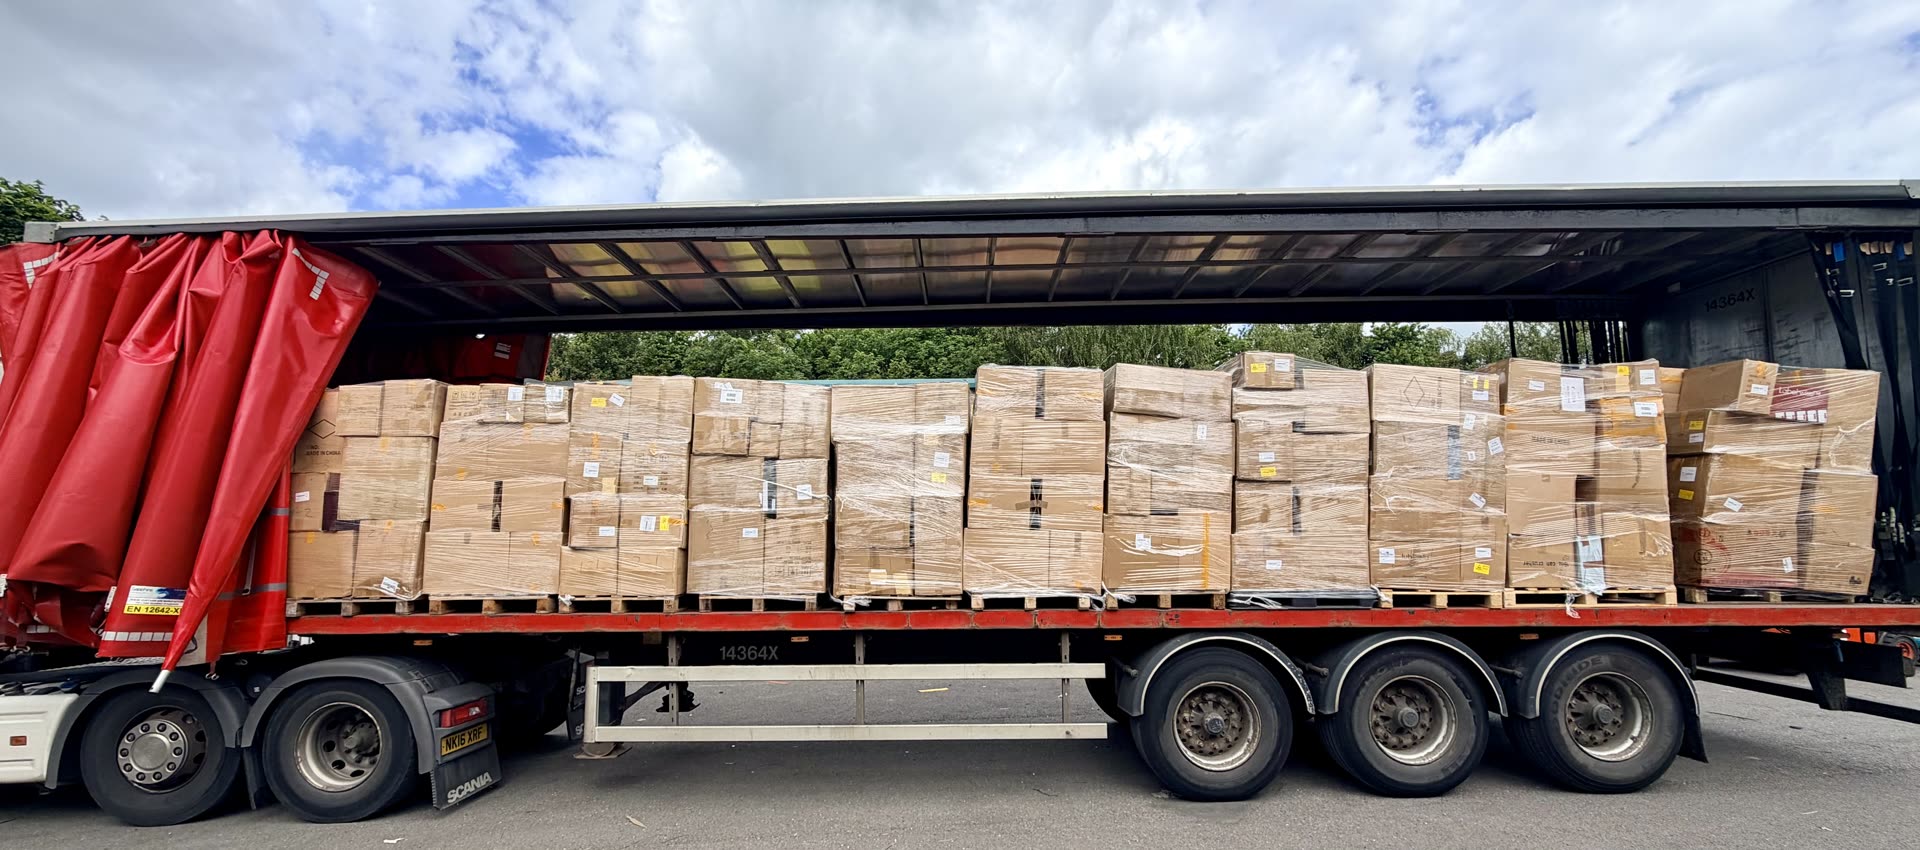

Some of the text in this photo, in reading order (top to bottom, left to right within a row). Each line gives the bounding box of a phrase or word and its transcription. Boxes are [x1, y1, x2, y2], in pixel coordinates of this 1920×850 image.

[1704, 288, 1755, 312] 14364X
[126, 605, 142, 613] EN
[720, 645, 779, 661] 14364X
[445, 726, 483, 752] NK16 XRF
[447, 771, 493, 804] SCANIA
